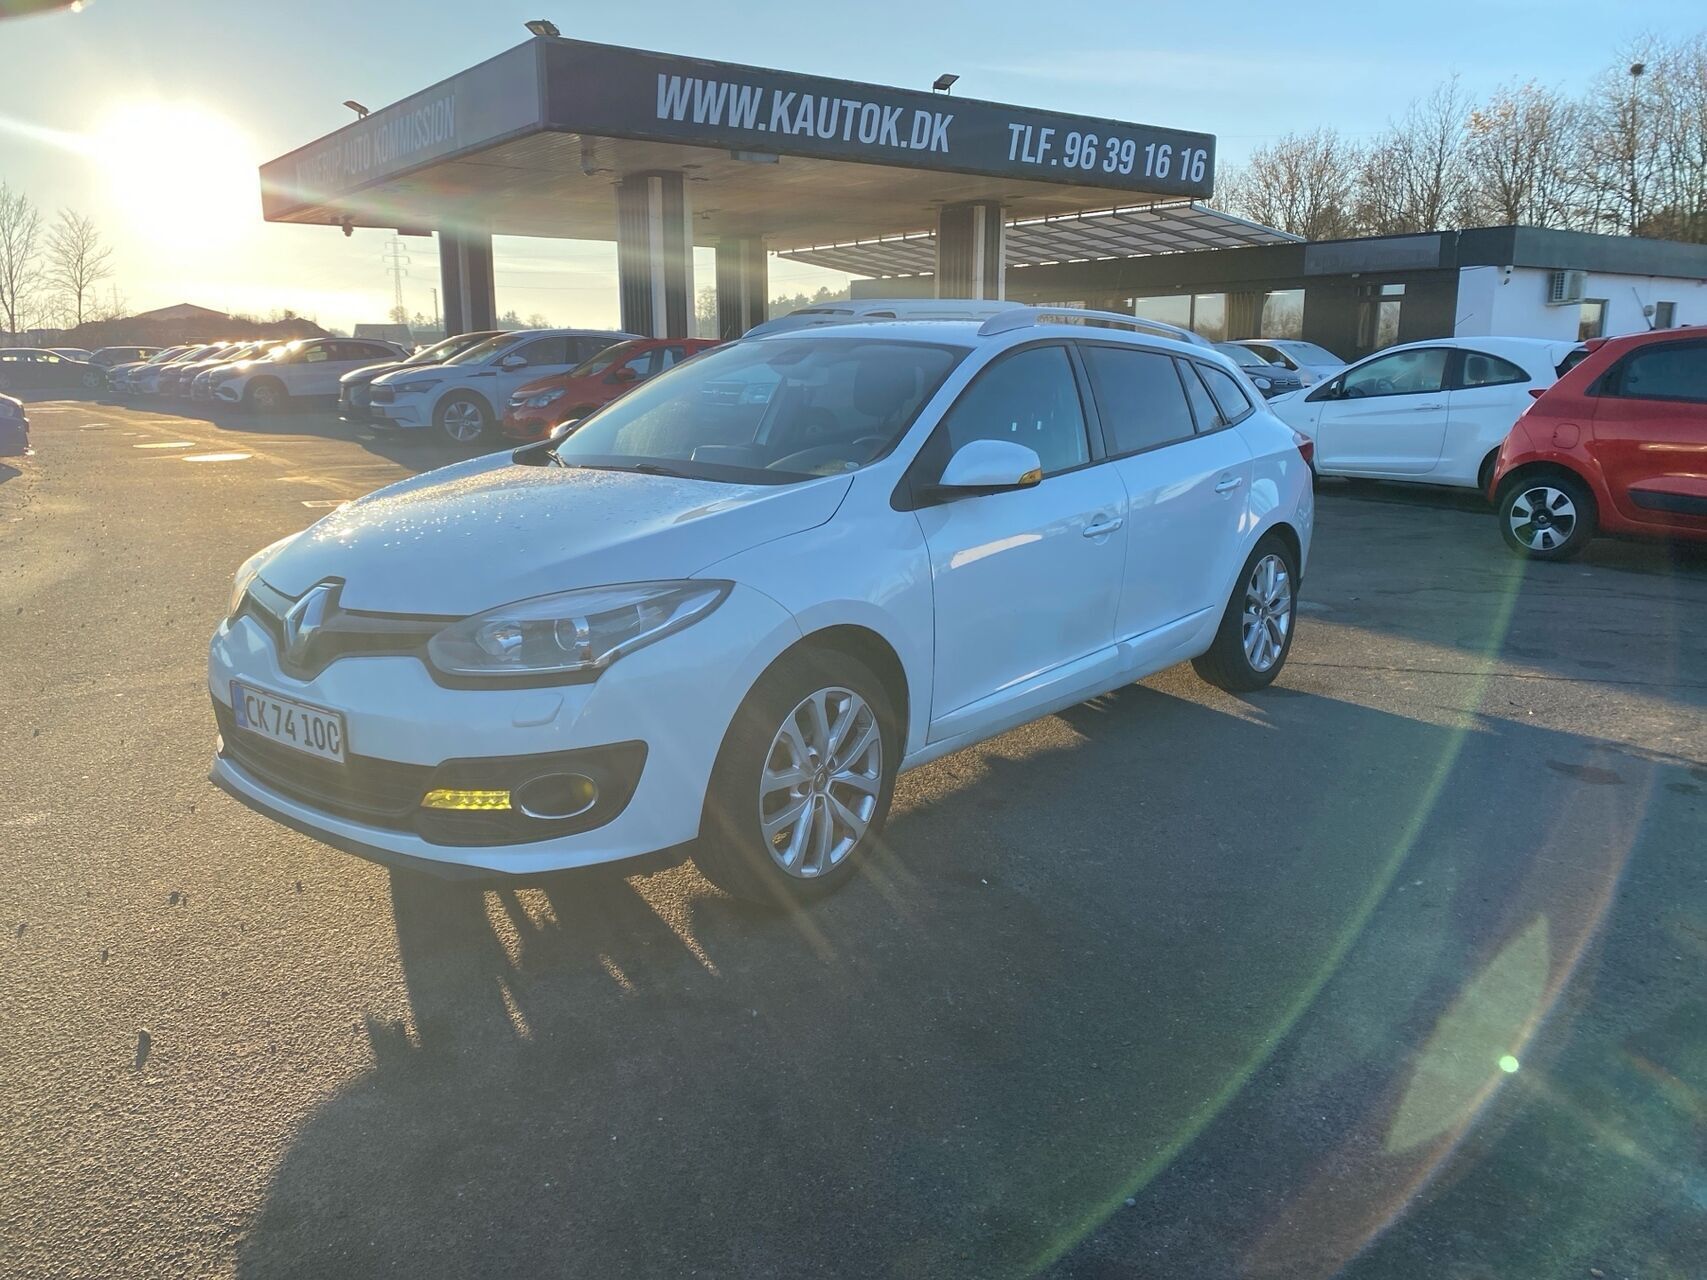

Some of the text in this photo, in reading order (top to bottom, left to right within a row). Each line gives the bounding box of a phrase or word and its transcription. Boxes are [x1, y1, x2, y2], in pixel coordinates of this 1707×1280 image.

[343, 132, 370, 176] AUTO
[374, 95, 456, 166] KOMMISSION
[656, 73, 954, 153] WWW.KAUTOK.DK
[1008, 123, 1207, 183] TLF. 96 39 16 16
[245, 695, 270, 732] CK
[272, 703, 297, 742] 74
